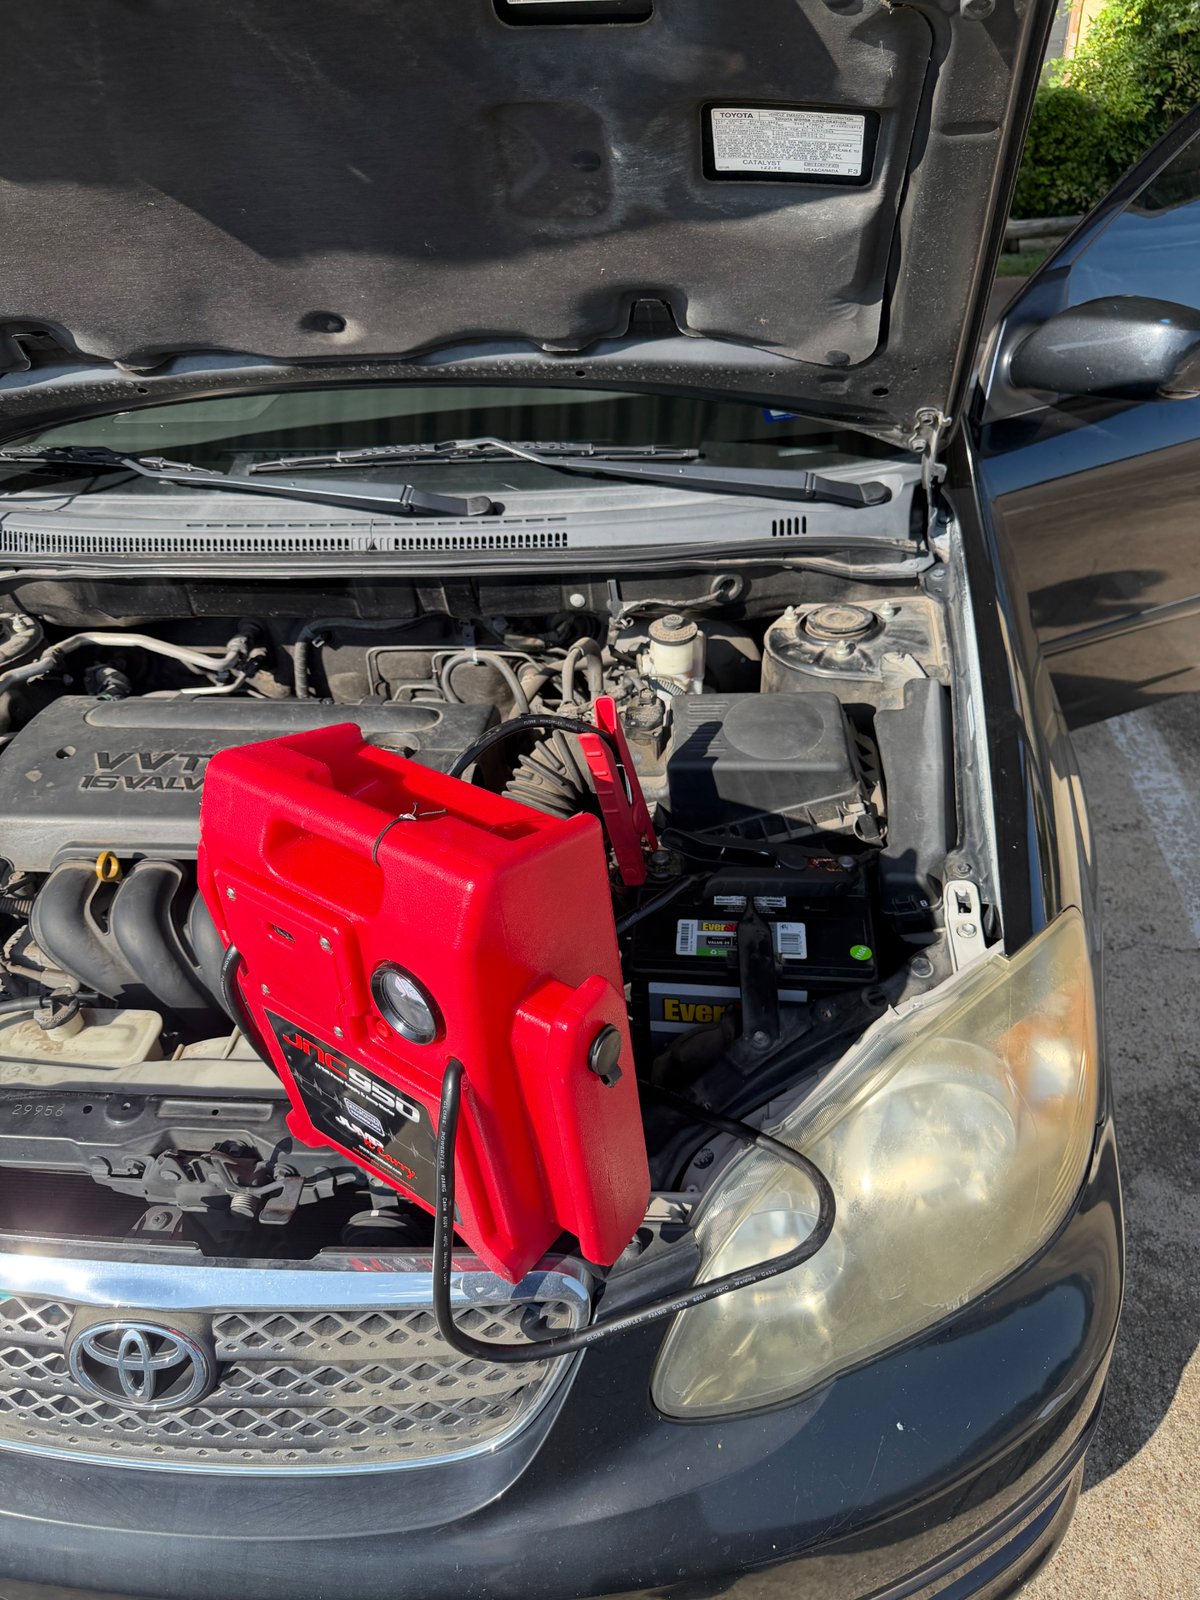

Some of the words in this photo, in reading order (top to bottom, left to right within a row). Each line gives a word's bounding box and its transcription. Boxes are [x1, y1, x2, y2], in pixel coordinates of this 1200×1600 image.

[80, 775, 118, 790] 16
[124, 776, 204, 792] VALV
[664, 998, 726, 1023] Ever
[12, 1104, 65, 1117] 29956
[609, 1316, 643, 1333] POWERFLEX
[671, 1301, 688, 1311] Cable
[734, 1275, 757, 1287] Welding
[761, 1268, 777, 1277] Cable
